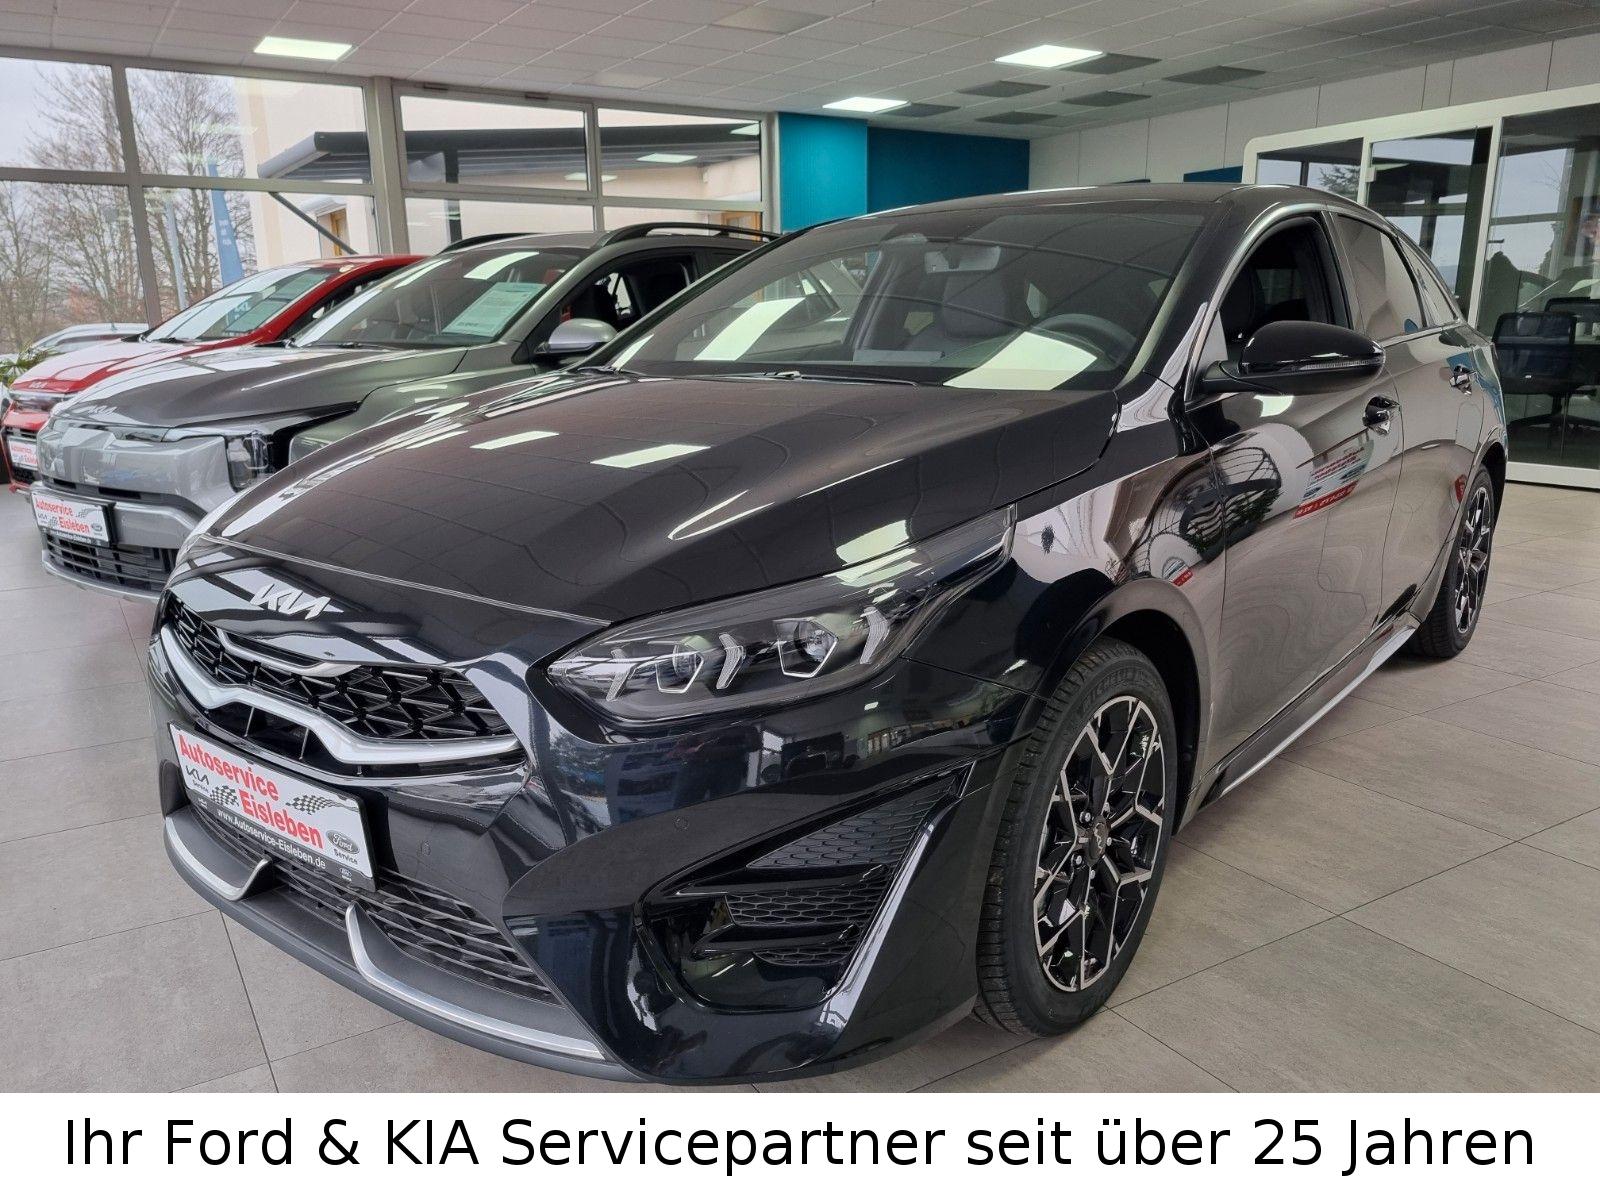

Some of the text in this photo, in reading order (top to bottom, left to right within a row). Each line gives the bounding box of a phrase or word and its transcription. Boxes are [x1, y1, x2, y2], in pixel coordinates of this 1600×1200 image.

[249, 583, 331, 620] KIA
[178, 734, 279, 801] Autoservice
[186, 765, 210, 786] KIA
[217, 809, 326, 869] www.Autoservice-Eisleben.de
[239, 789, 324, 849] Eisleben
[332, 833, 353, 851] Ford
